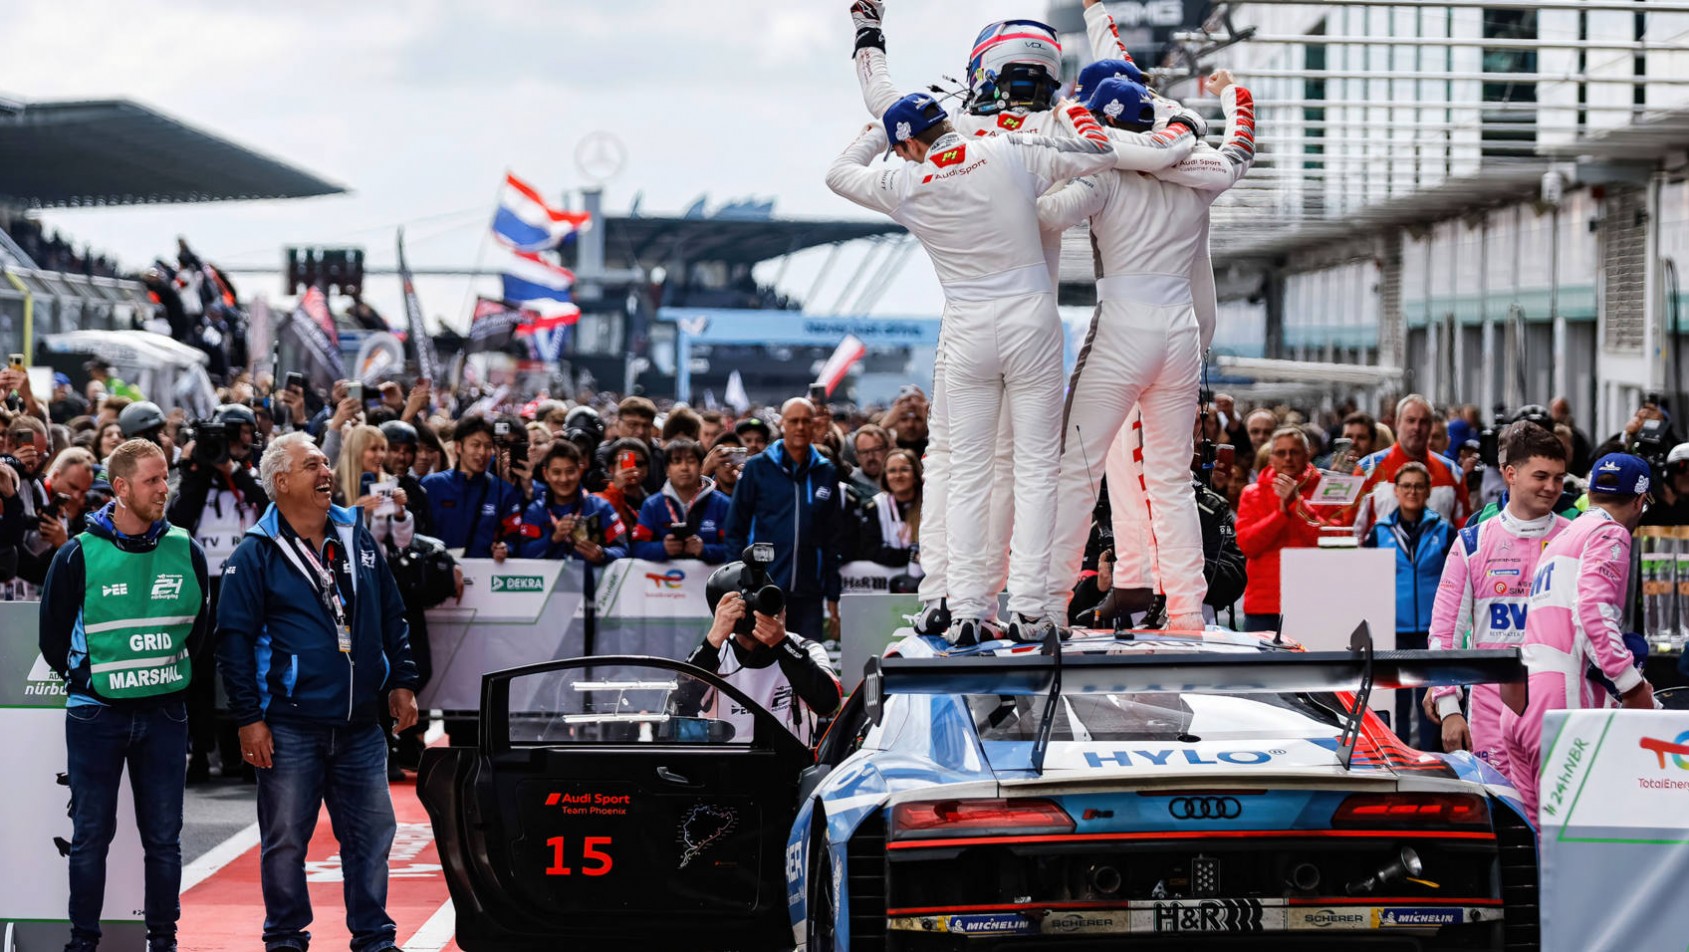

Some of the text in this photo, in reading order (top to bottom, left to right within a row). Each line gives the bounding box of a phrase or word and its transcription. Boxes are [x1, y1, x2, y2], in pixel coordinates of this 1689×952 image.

[935, 159, 987, 180] Audi Sport
[201, 536, 219, 547] TV
[506, 578, 543, 590] DEKRA
[129, 633, 172, 651] GRID
[109, 665, 183, 690] MARSHAL
[25, 682, 67, 695] nürbu
[1083, 749, 1272, 767] HYLO
[562, 793, 630, 805] Audi Sport
[562, 806, 626, 815] Team Phoenix
[546, 835, 613, 876] 15
[966, 918, 1029, 931] MICHELIN
[1051, 918, 1113, 928] SCHERER
[1305, 914, 1363, 923] SCHERER
[1398, 913, 1453, 923] MICHELIN
